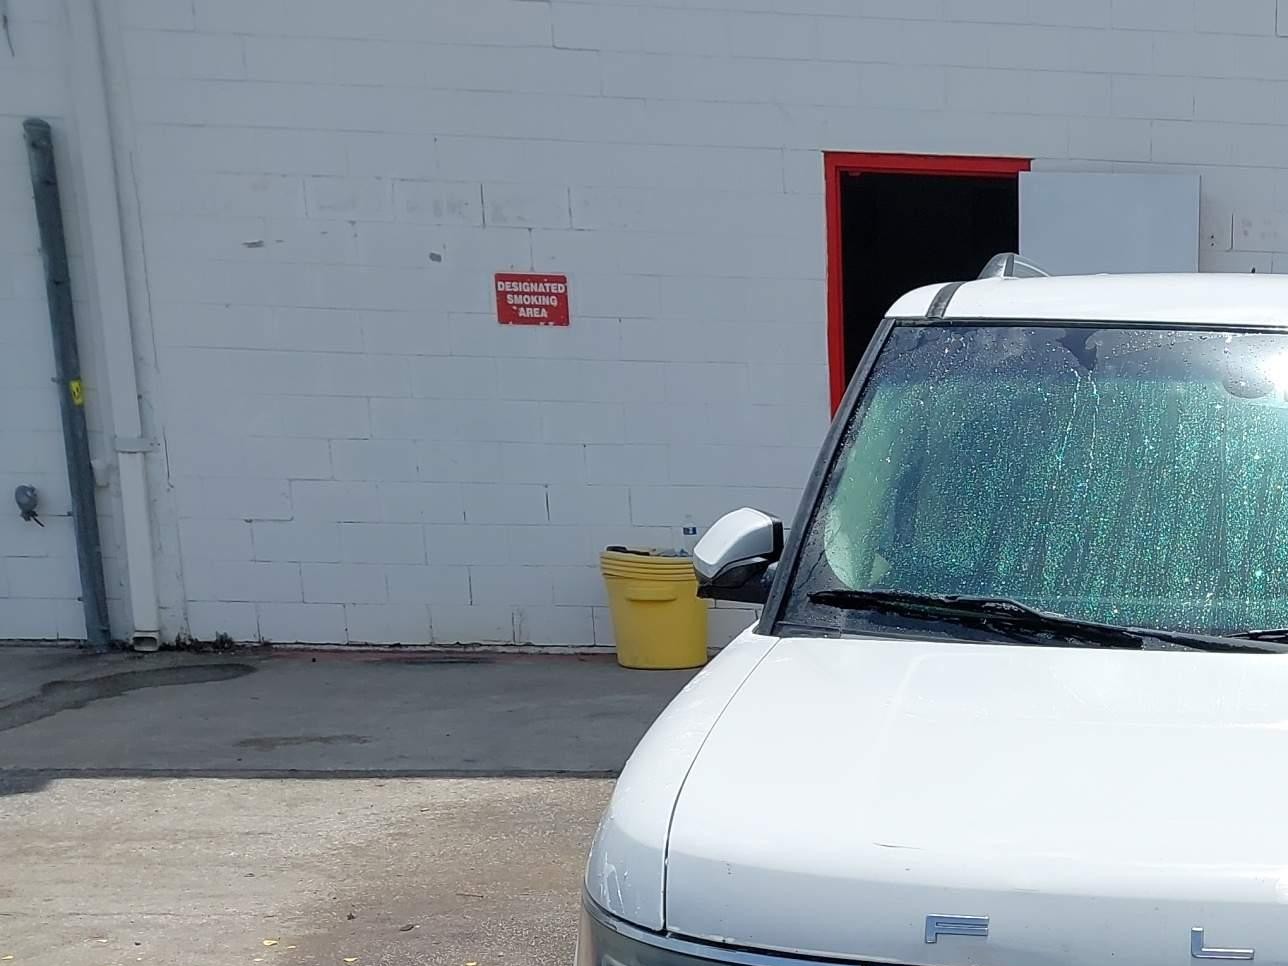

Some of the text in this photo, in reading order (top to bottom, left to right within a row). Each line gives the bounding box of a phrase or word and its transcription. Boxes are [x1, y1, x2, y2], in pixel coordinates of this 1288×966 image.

[497, 281, 566, 293] DESIGNATED
[506, 294, 558, 306] SMOKING
[518, 307, 548, 318] AREA
